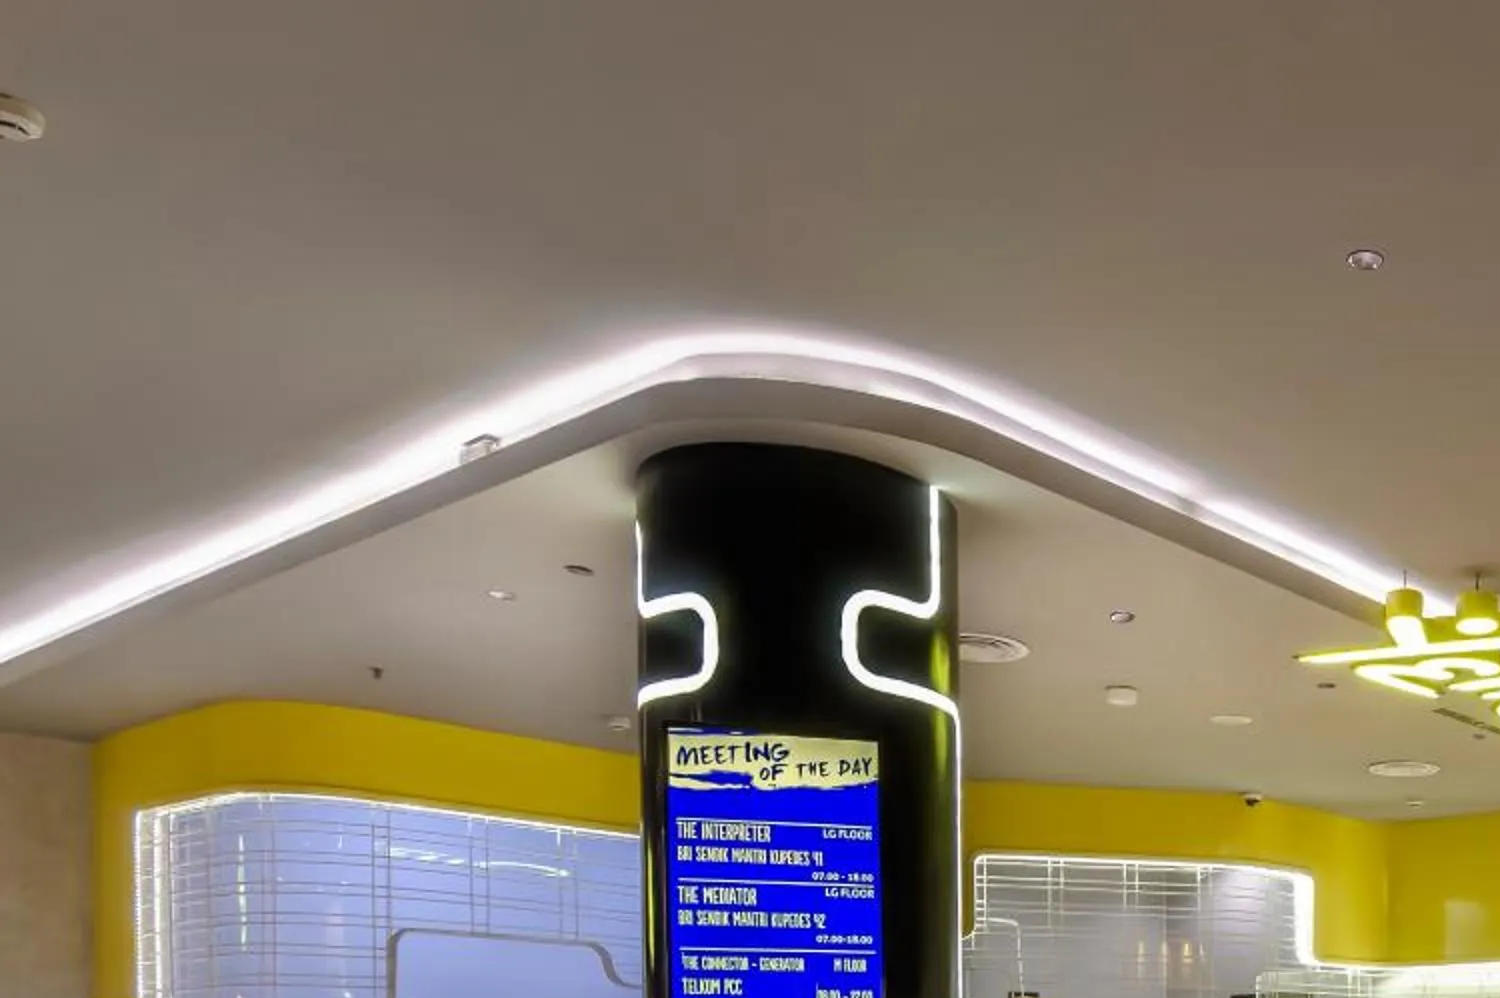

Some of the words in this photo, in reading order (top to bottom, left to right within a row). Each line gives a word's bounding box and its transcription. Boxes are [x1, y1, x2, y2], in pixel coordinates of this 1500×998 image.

[676, 742, 790, 766] MEETING
[759, 763, 789, 780] OF
[796, 761, 829, 778] THE
[838, 757, 873, 777] DAY
[677, 821, 698, 839] THE
[701, 823, 771, 842] INTERPRETER
[823, 828, 836, 839] LG
[838, 829, 873, 841] FLOOR
[678, 886, 699, 904] THE
[703, 887, 757, 906] MEDIATOR
[825, 888, 839, 898] LG
[841, 889, 875, 899] FLOOR
[682, 955, 699, 971] THE
[843, 958, 867, 972] FLOOR
